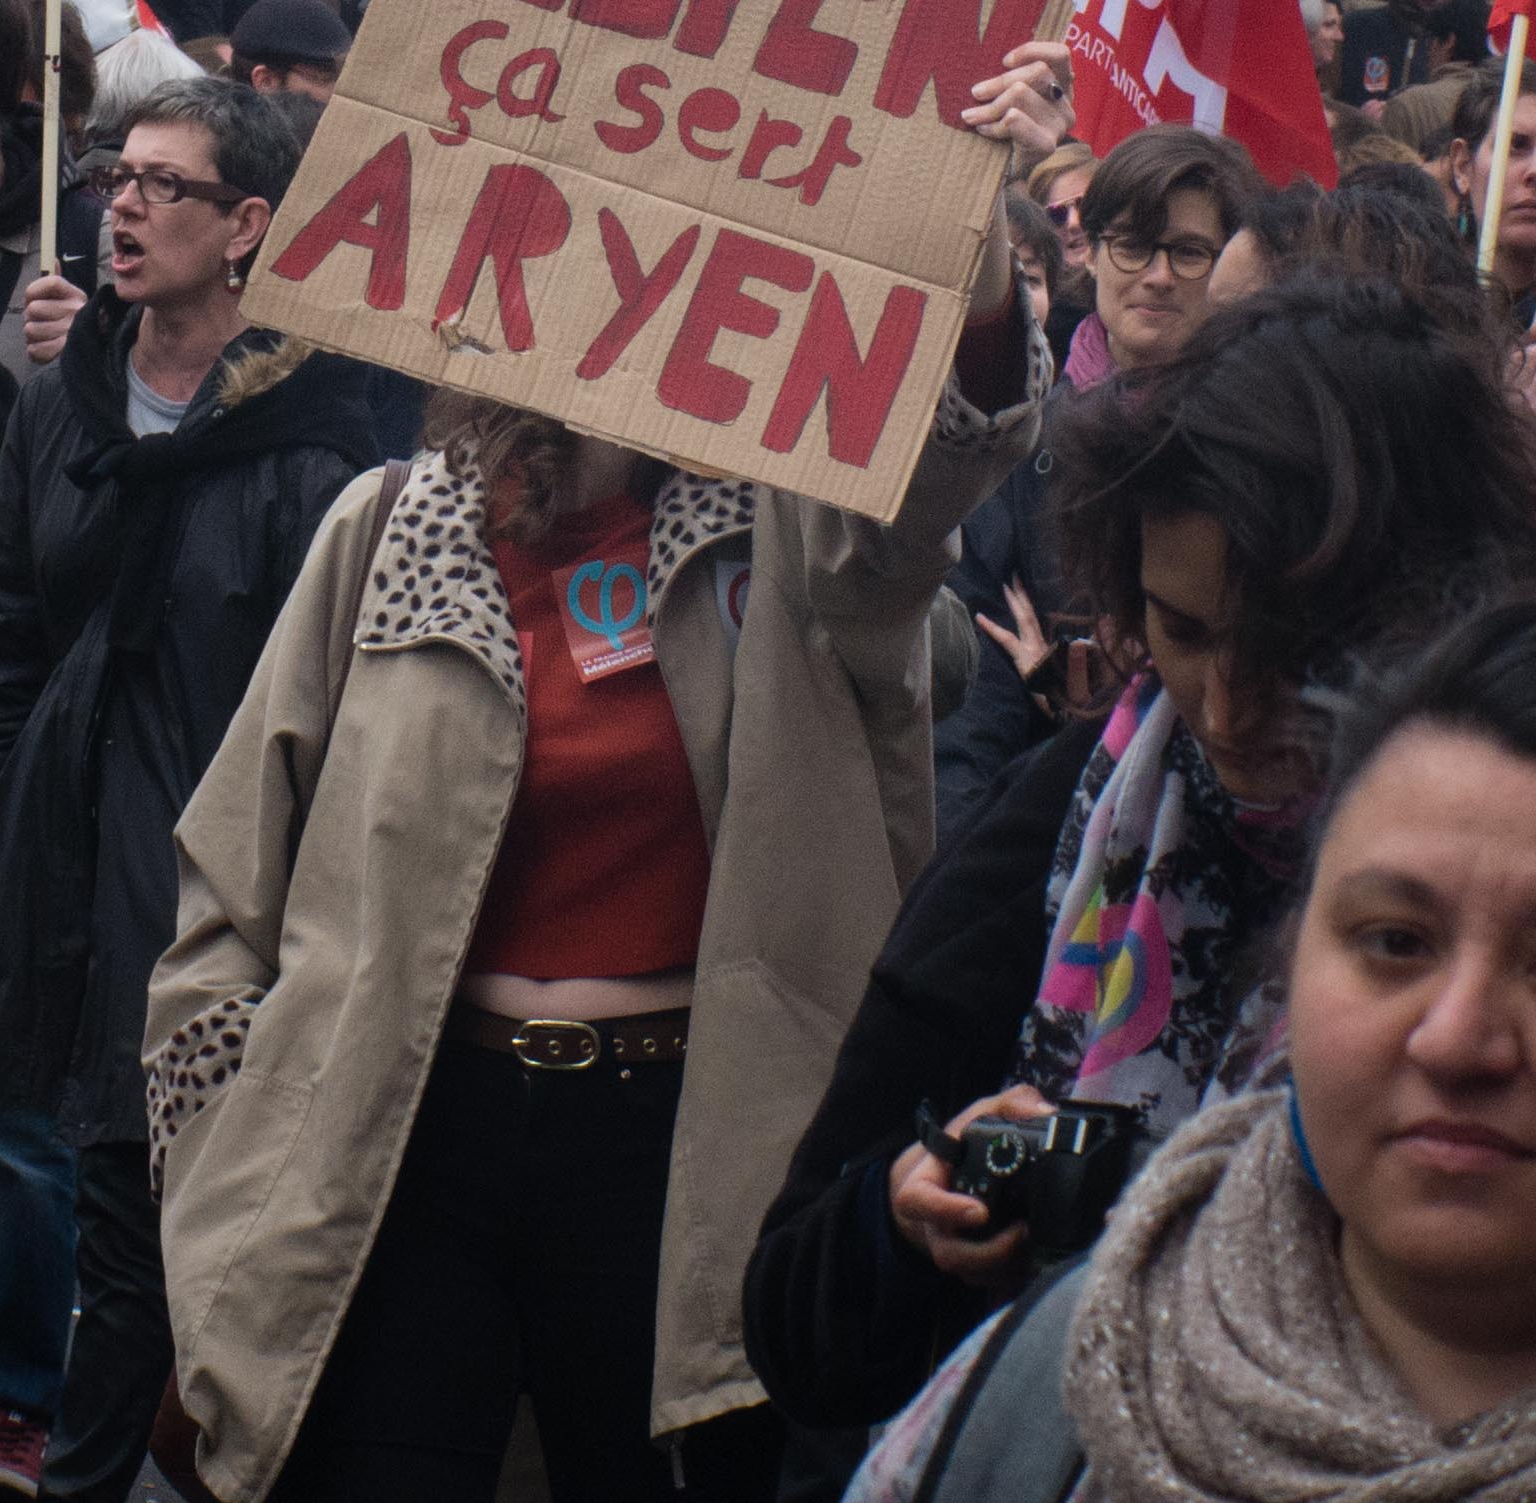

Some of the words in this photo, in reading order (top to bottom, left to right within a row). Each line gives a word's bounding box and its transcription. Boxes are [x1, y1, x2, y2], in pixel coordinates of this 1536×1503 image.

[430, 18, 566, 148] ça
[594, 62, 863, 205] sert
[1065, 23, 1114, 71] PART
[269, 132, 928, 470] ARYEN
